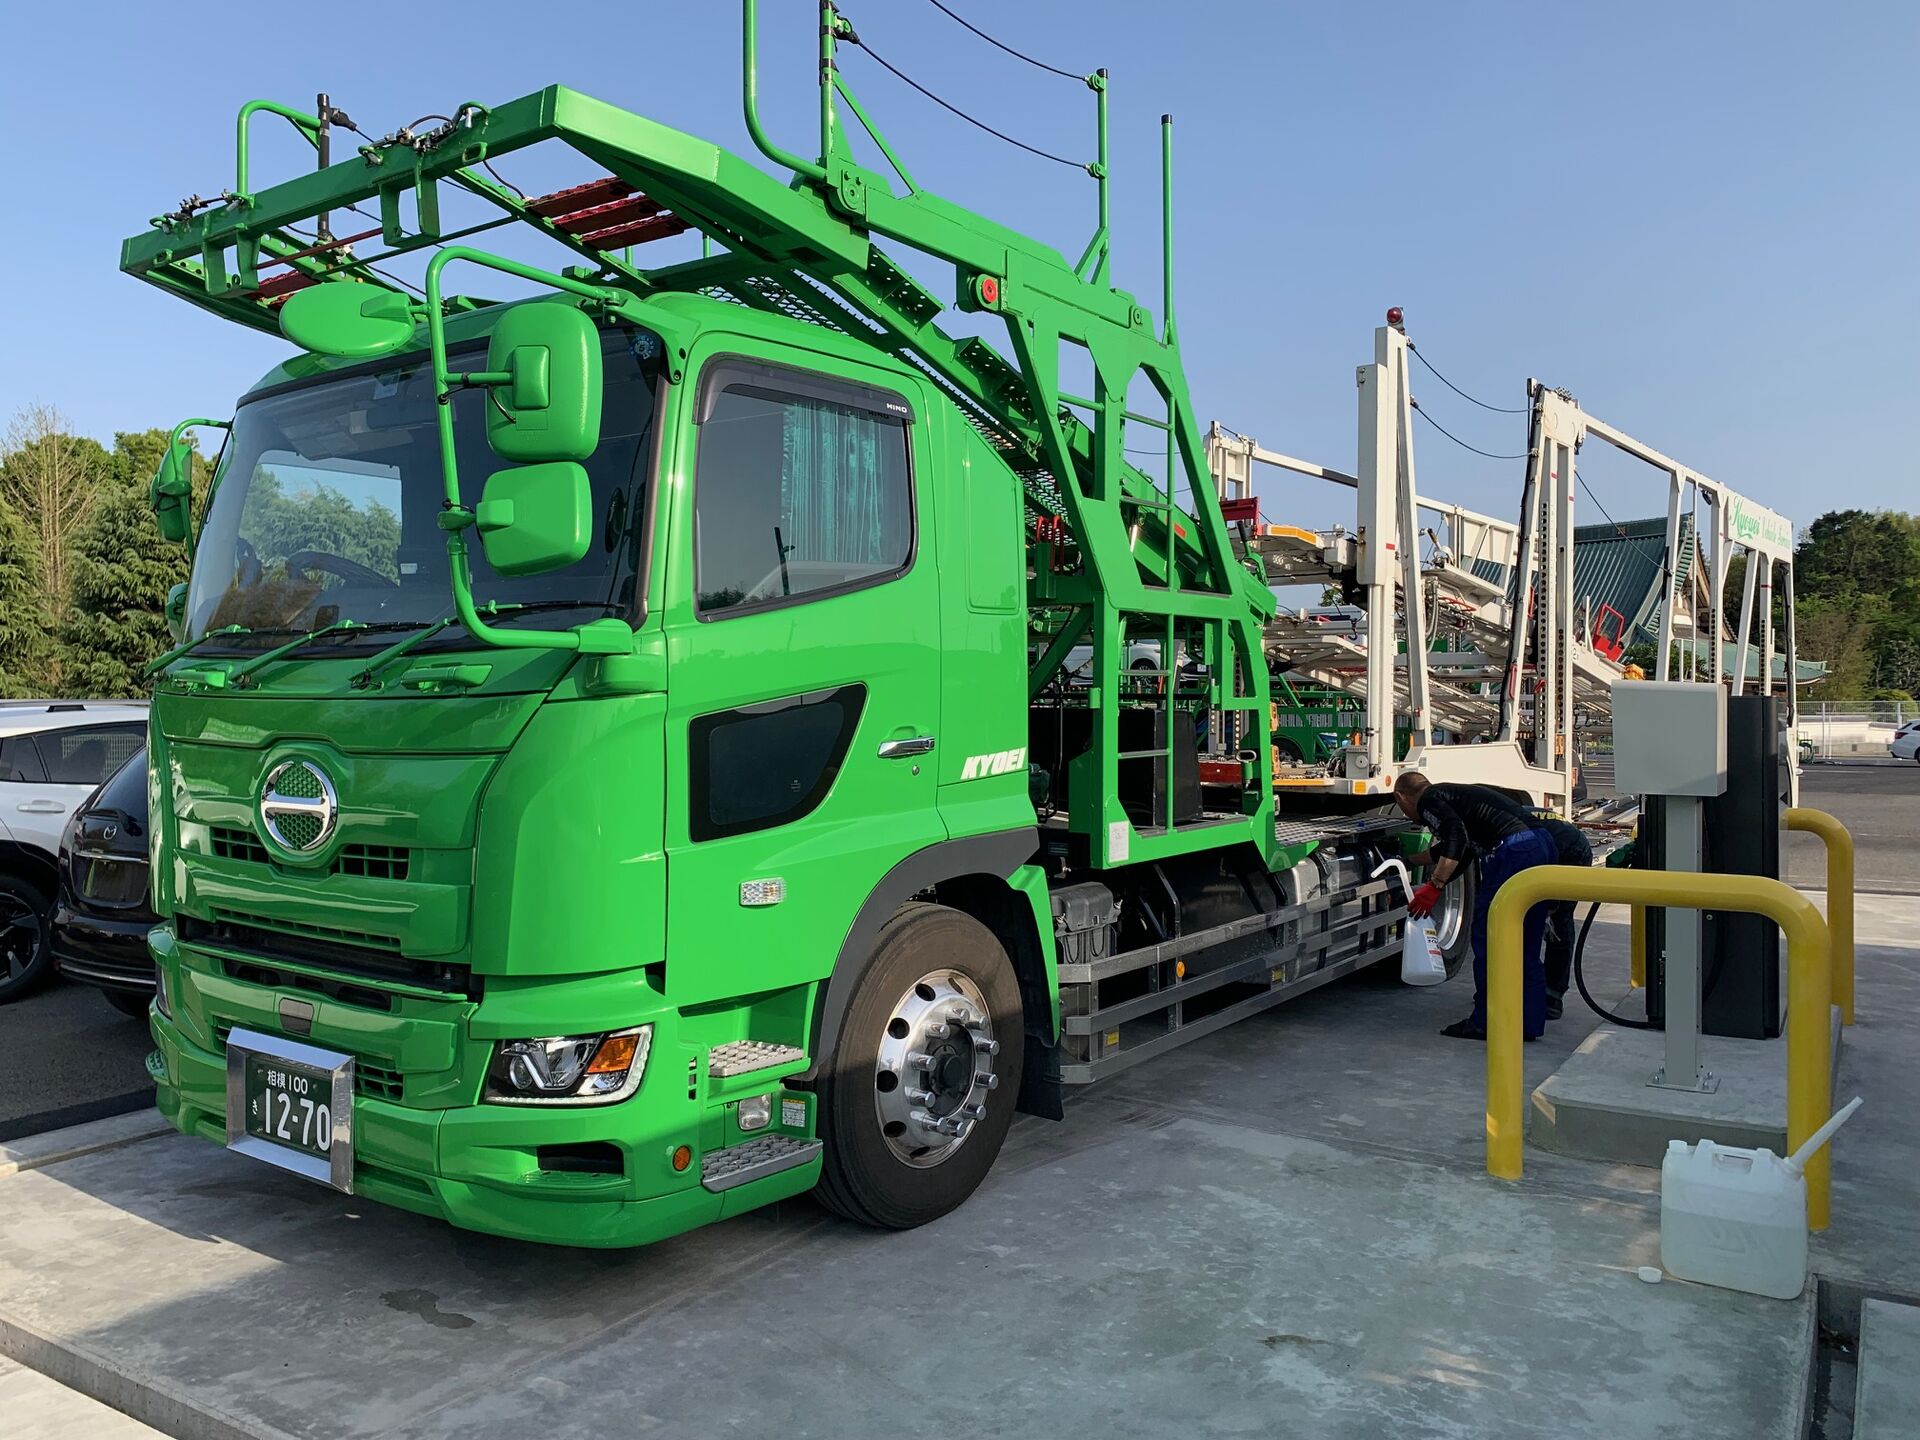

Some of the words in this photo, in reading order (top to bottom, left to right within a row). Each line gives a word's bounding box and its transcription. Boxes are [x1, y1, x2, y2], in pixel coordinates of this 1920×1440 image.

[886, 402, 908, 413] HINO
[960, 747, 1027, 780] KYOEI
[267, 1069, 286, 1089] 相模
[288, 1074, 308, 1095] 100
[252, 1099, 258, 1115] き
[265, 1087, 331, 1152] 12-70
